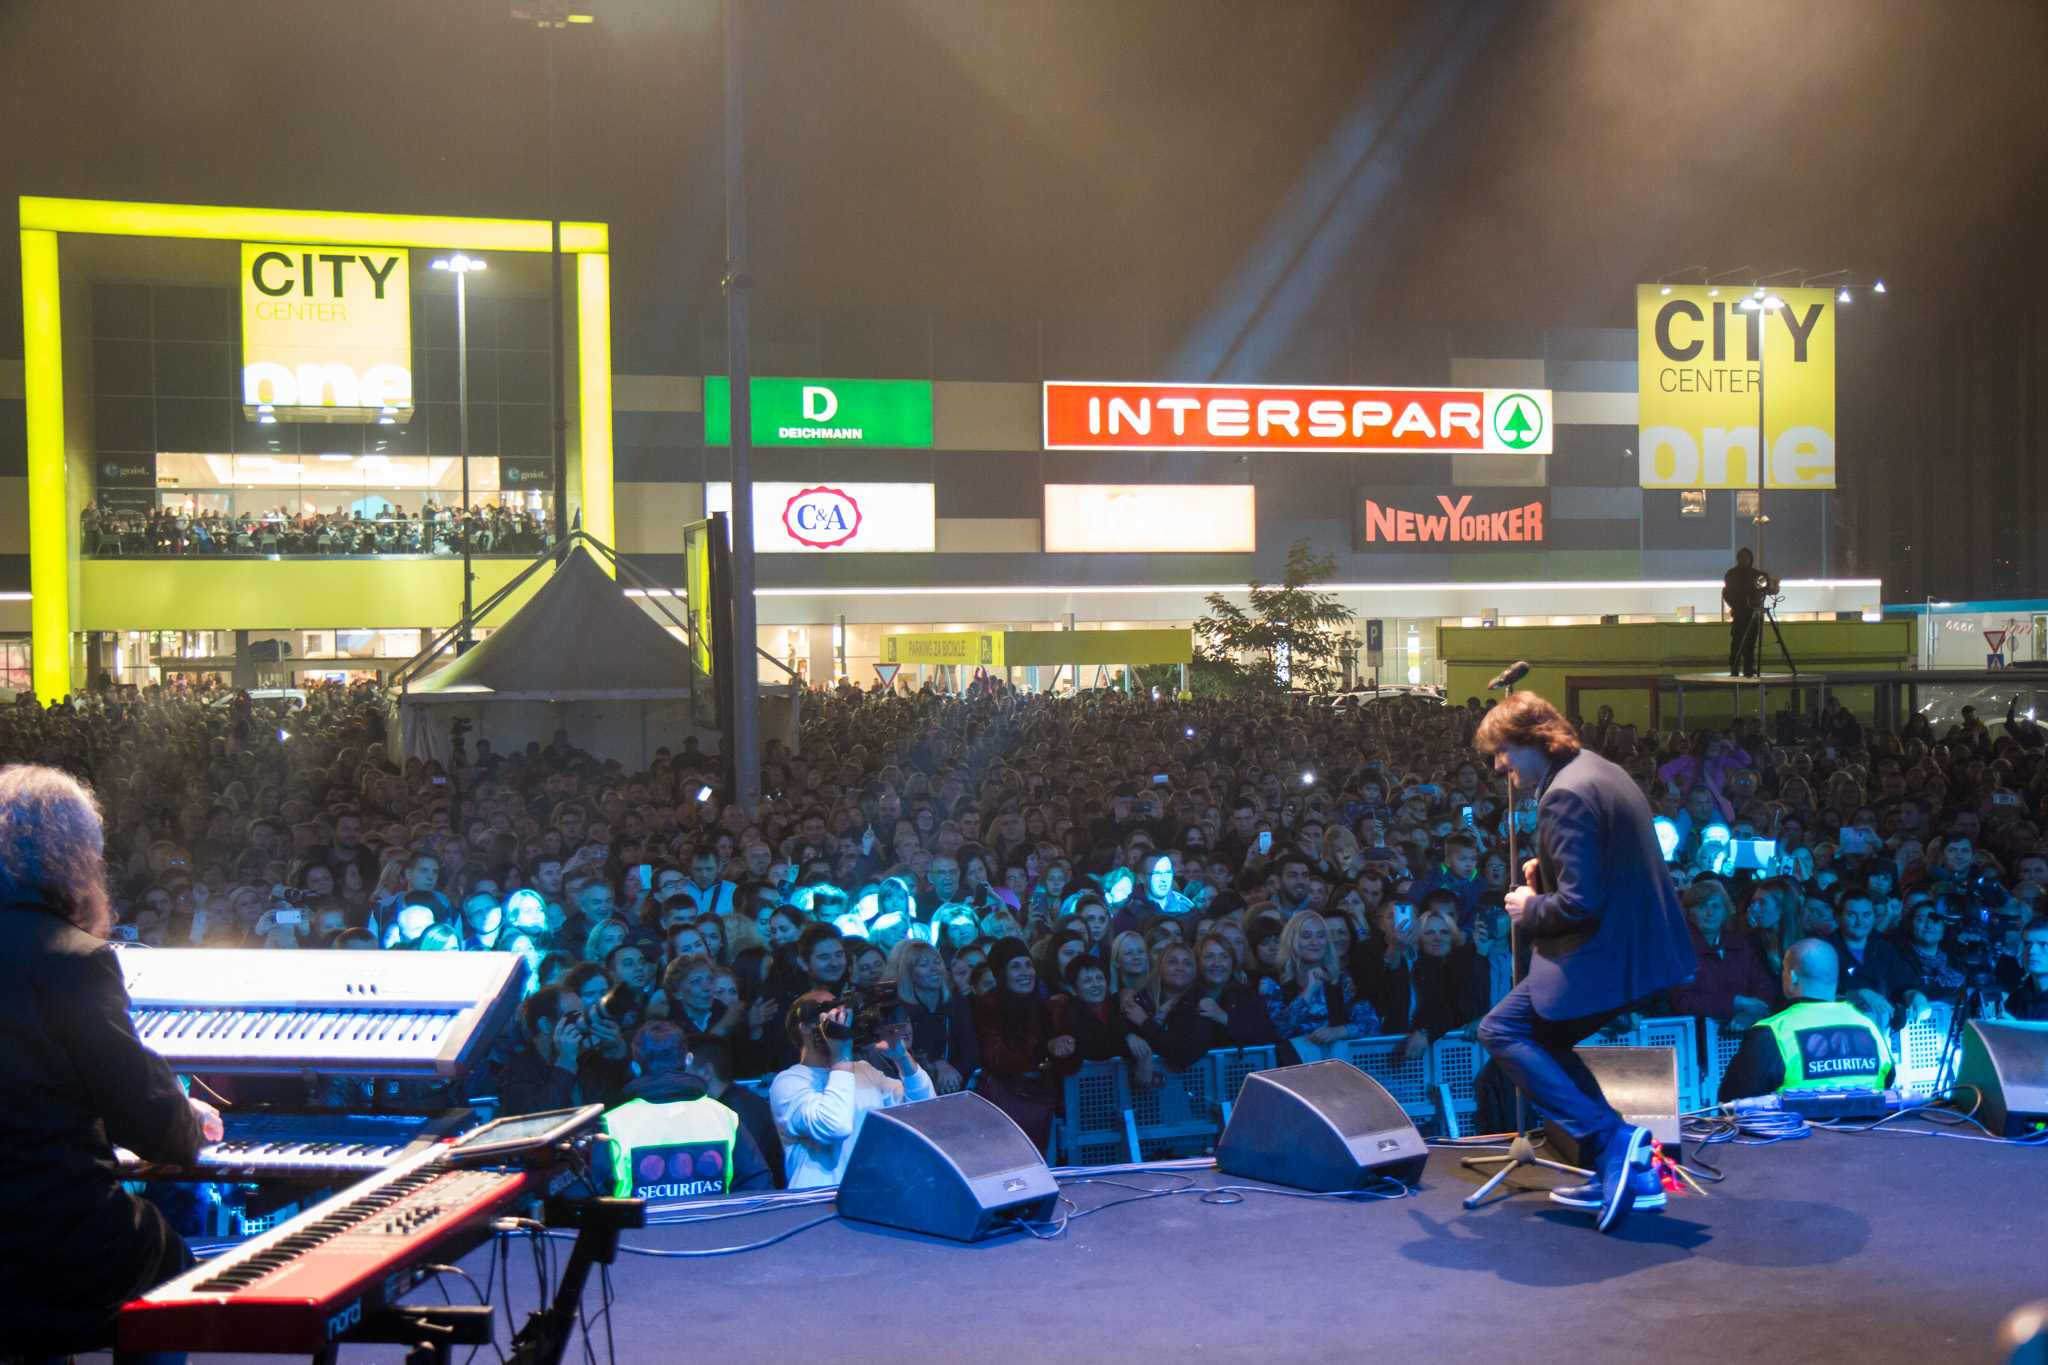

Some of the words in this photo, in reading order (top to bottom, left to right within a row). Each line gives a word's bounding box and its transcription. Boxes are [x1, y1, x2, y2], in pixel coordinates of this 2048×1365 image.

[251, 251, 400, 300] CITY
[256, 301, 347, 322] CENTER
[1654, 299, 1826, 363] CITY
[242, 361, 412, 408] one
[1659, 368, 1761, 393] CENTER
[803, 386, 839, 422] D
[1088, 397, 1481, 439] INTERSPAR
[779, 427, 863, 439] DEICHMANN
[1638, 425, 1836, 486] one
[797, 504, 849, 530] C&A
[908, 640, 933, 657] PARKING
[933, 640, 942, 657] ZA
[942, 640, 966, 657] BICIKLE
[1808, 1057, 1877, 1073] SECURITAS
[637, 1180, 723, 1199] SECURITAS
[328, 1297, 361, 1340] nord
